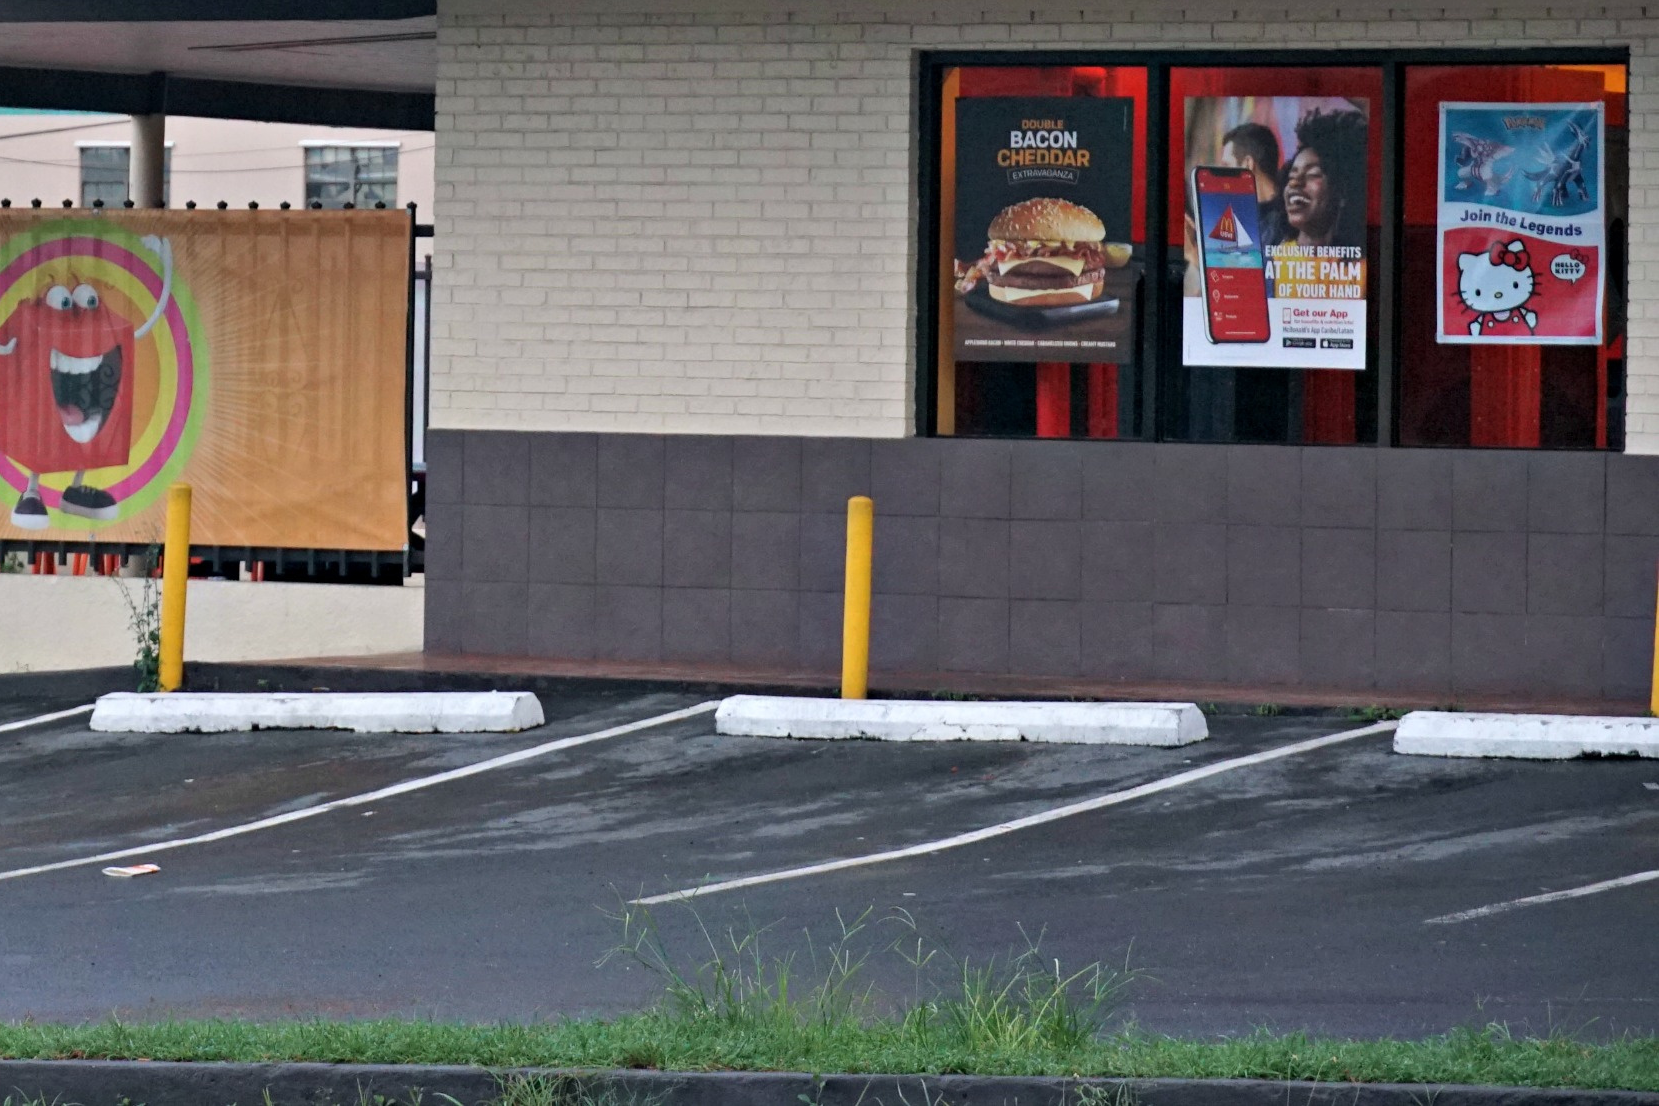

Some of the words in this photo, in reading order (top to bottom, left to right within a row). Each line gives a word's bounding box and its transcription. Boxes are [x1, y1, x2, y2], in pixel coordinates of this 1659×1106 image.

[1022, 119, 1064, 129] DOUBLE
[1010, 130, 1078, 148] BACON
[997, 149, 1090, 167] CHEDDAR
[1012, 169, 1074, 180] EXTRAVAGANZA
[1460, 209, 1492, 222] Join
[1495, 212, 1517, 226] the
[1519, 217, 1582, 236] Legends
[1265, 245, 1315, 257] EXCLUSIVE
[1316, 246, 1361, 258] BENEFITS
[1265, 260, 1283, 279] AT
[1286, 261, 1316, 279] THE
[1320, 261, 1361, 281] PALM
[1278, 283, 1293, 297] OF
[1296, 284, 1326, 298] YOUR
[1329, 284, 1361, 298] HAND
[1293, 308, 1310, 317] Get
[1330, 309, 1348, 319] App
